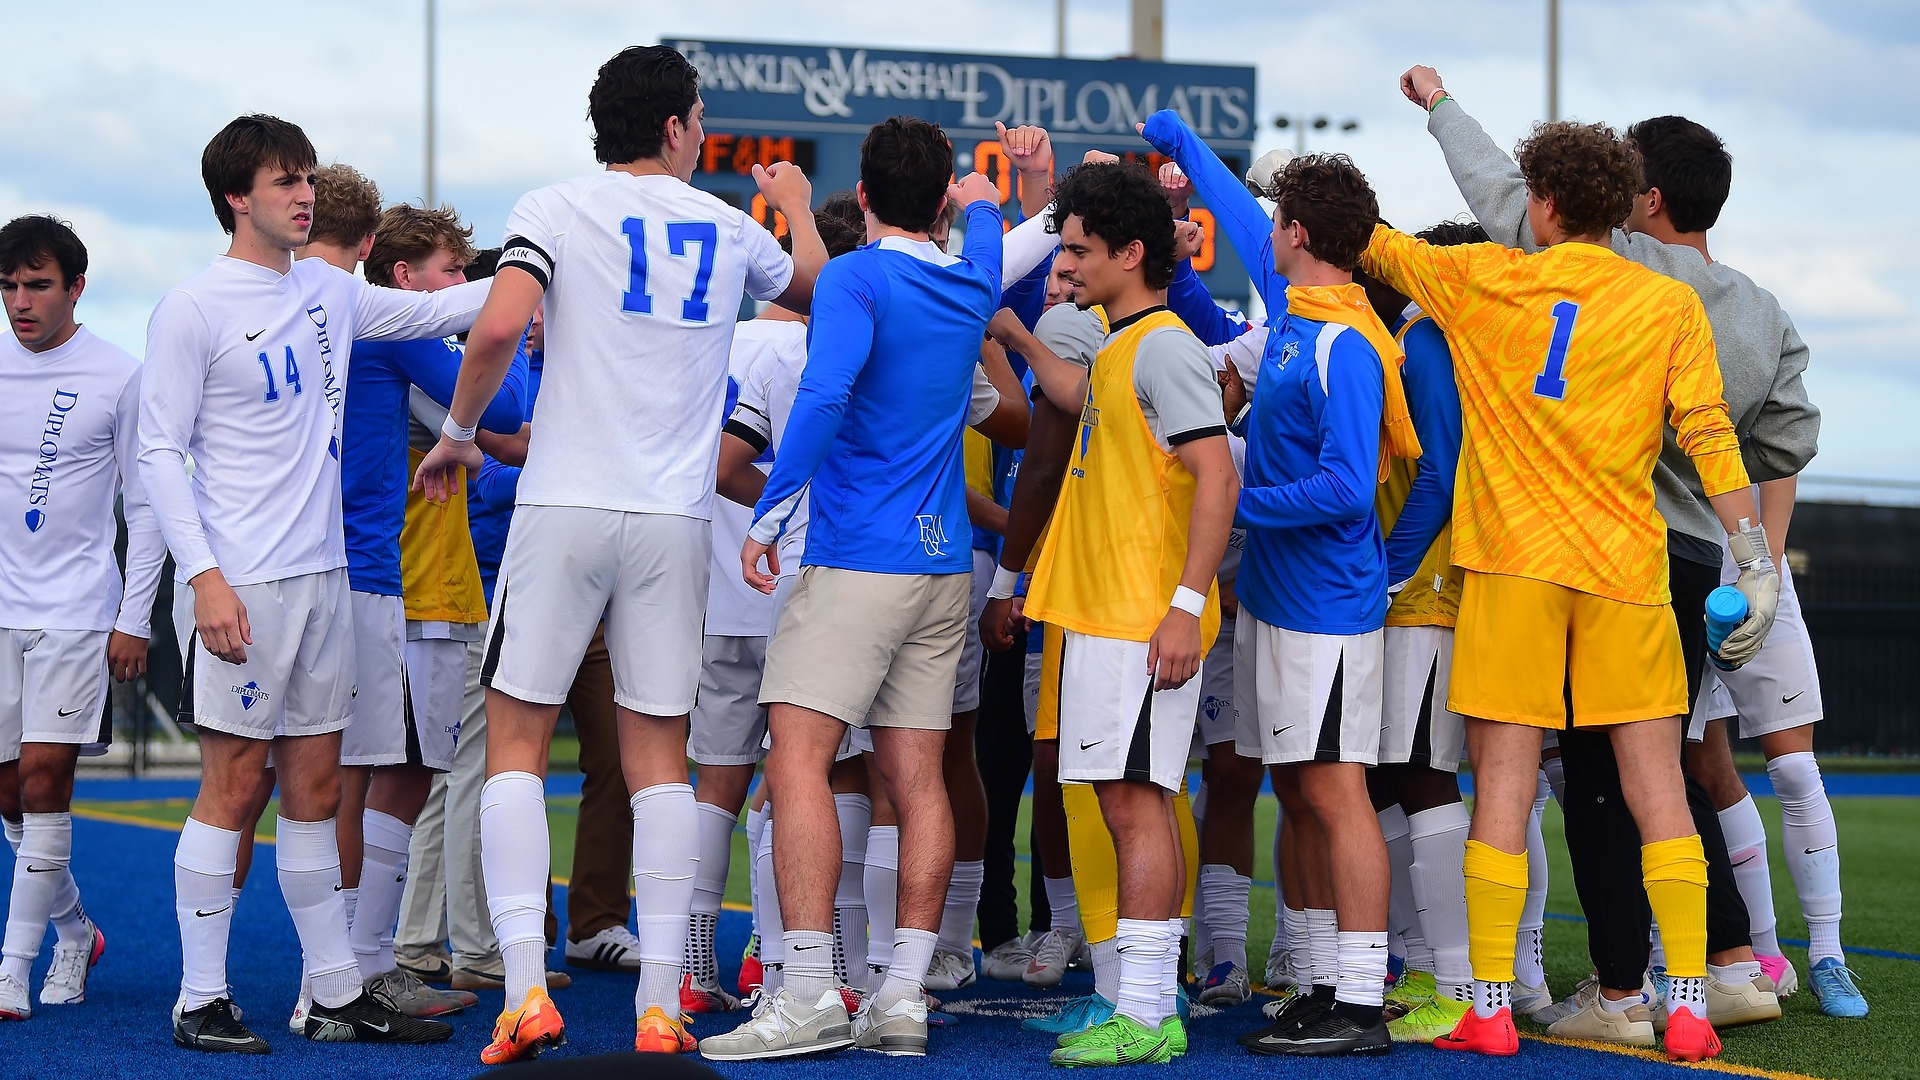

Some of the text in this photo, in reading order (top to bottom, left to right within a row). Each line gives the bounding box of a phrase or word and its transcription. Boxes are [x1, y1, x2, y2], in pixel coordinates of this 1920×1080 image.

[826, 49, 989, 102] MARSHALL
[620, 214, 719, 324] 17
[258, 343, 302, 403] 14
[1532, 300, 1581, 401] 1
[28, 387, 80, 506] DIPLOMATS
[231, 684, 270, 701] DIPLOMATS
